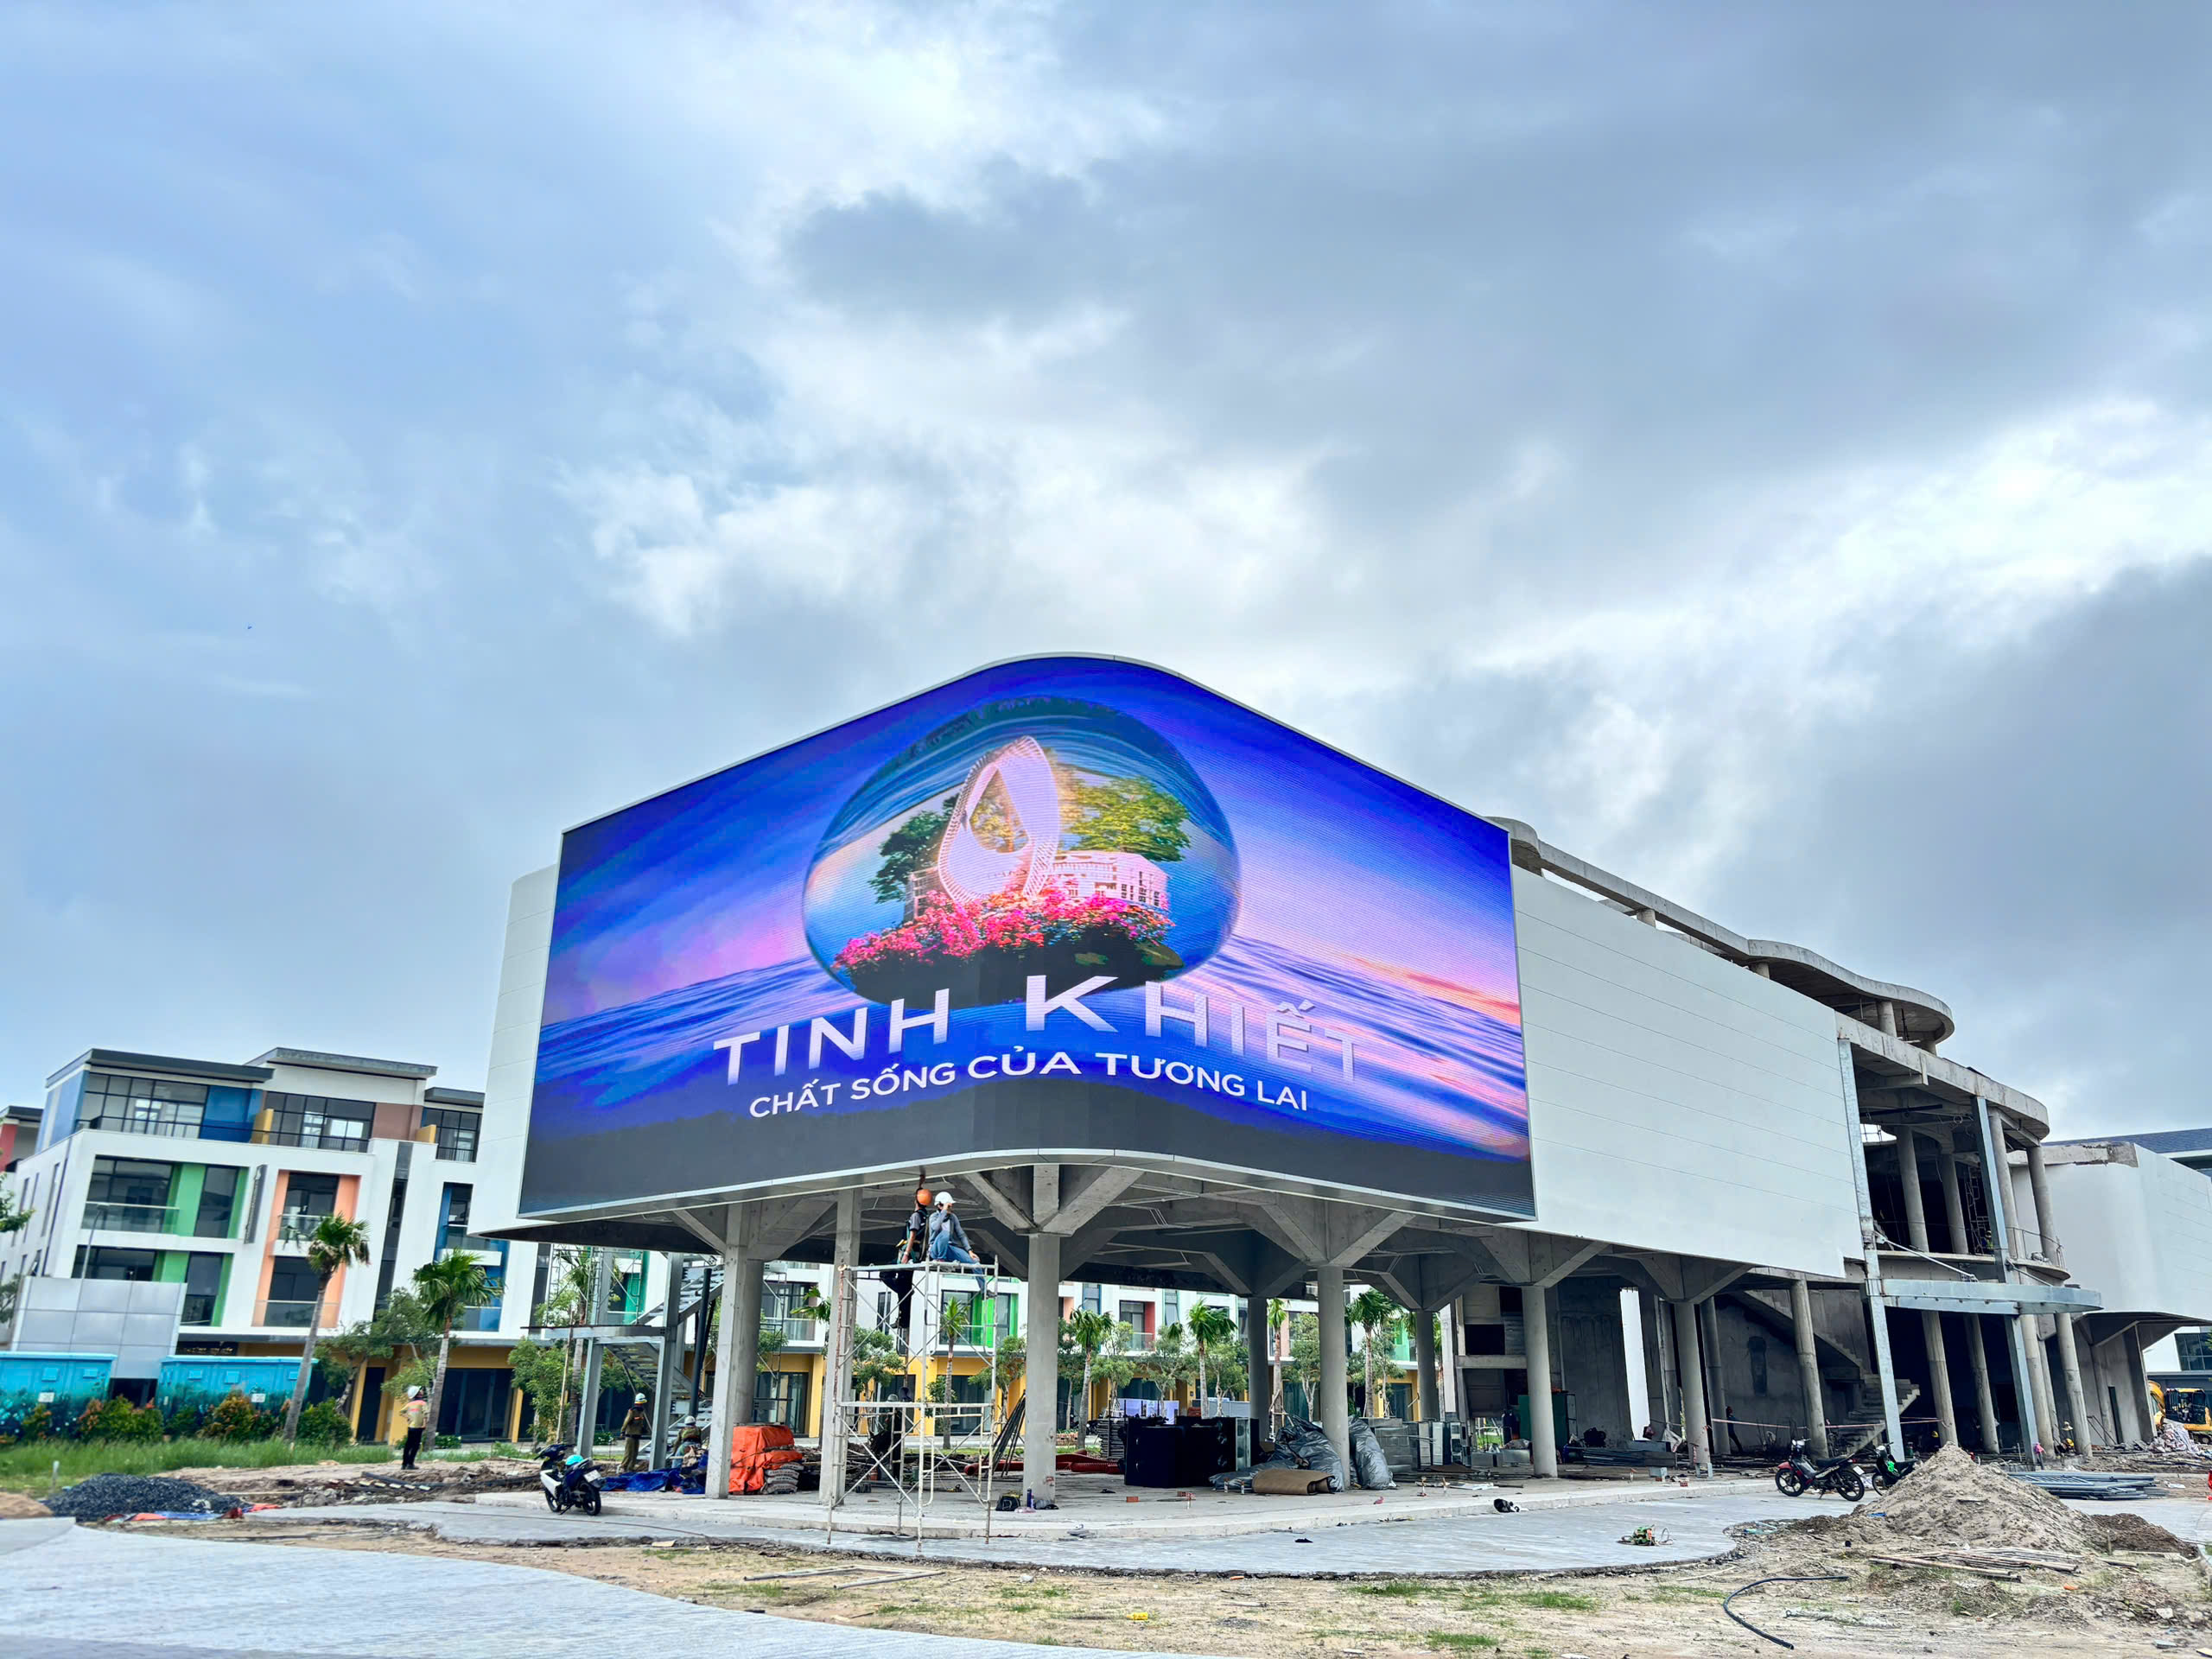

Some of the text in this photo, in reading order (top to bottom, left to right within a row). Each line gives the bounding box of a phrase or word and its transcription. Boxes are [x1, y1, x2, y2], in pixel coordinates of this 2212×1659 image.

[713, 975, 1368, 1086] TINH KHIẾT
[749, 1046, 1307, 1118] CHẤT SỐNG CỦA TƯƠNG LAI
